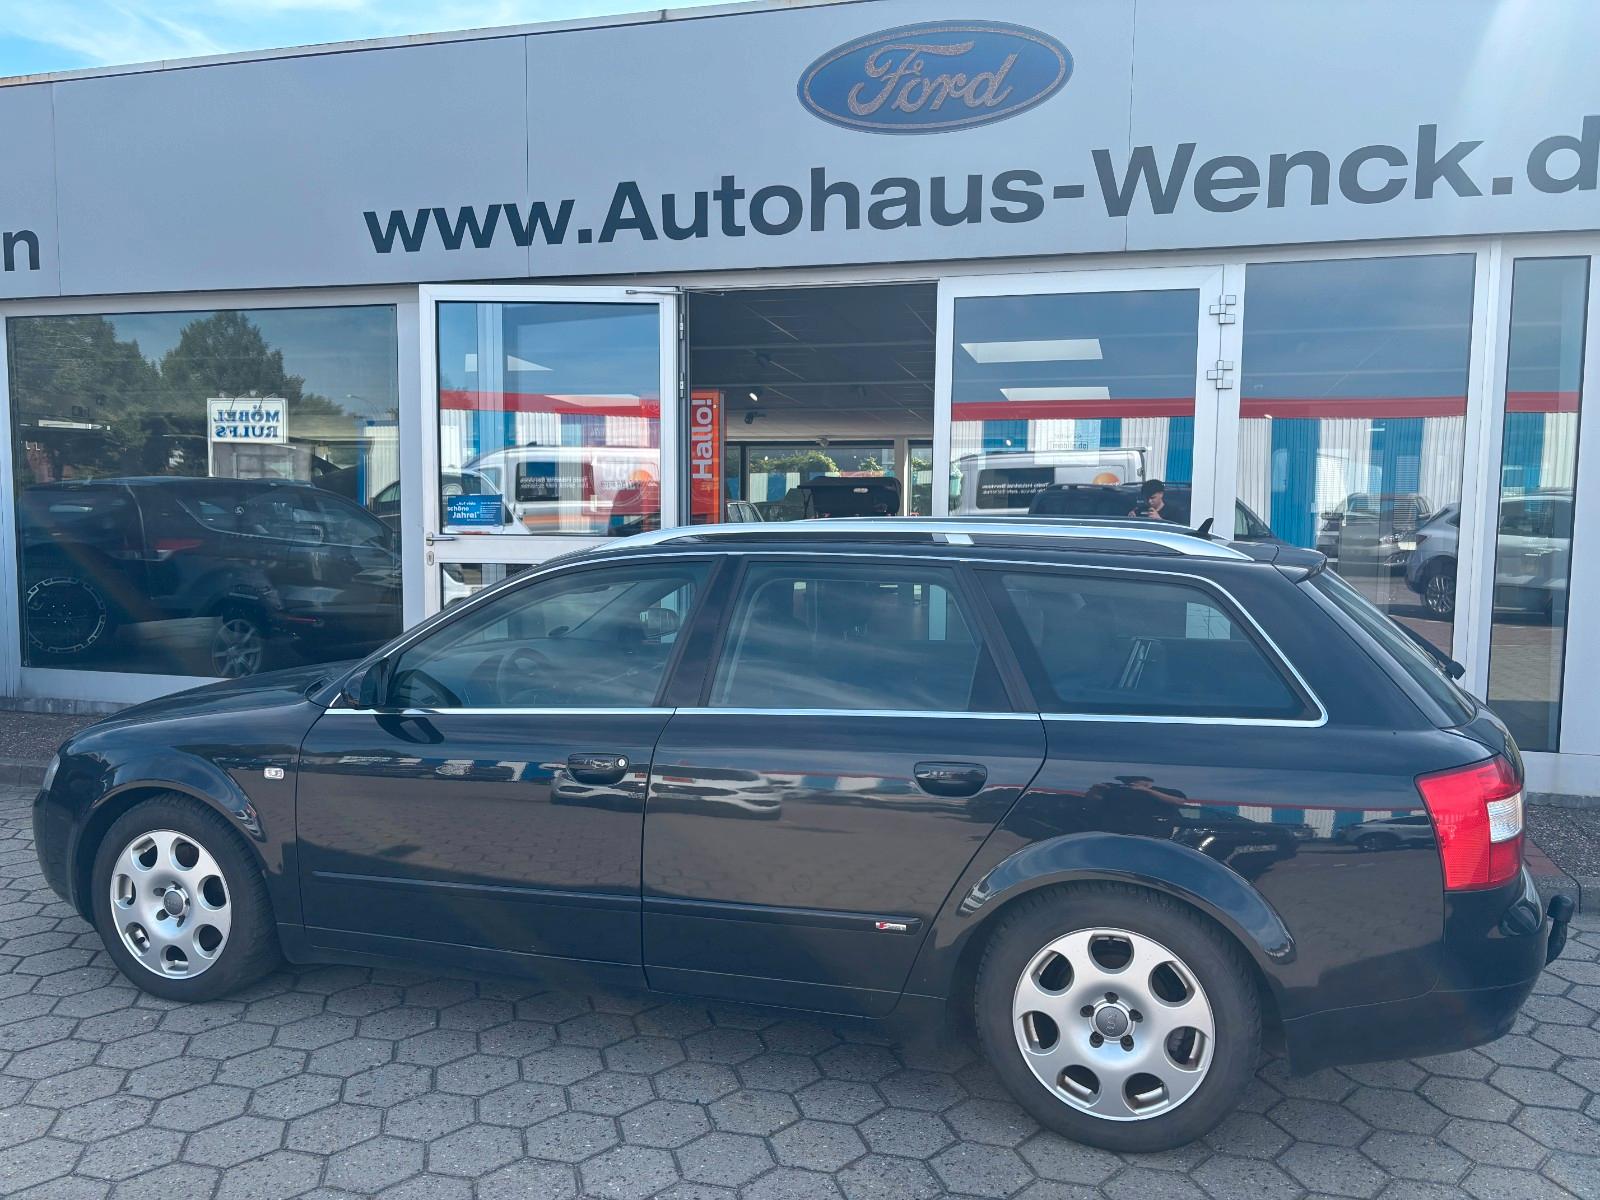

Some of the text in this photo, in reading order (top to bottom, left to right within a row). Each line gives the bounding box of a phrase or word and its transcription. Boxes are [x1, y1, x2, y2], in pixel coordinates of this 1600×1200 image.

[847, 40, 1018, 116] Ford
[363, 115, 1600, 254] www.Autohaus-Wenck.d
[692, 398, 713, 479] Hallo!
